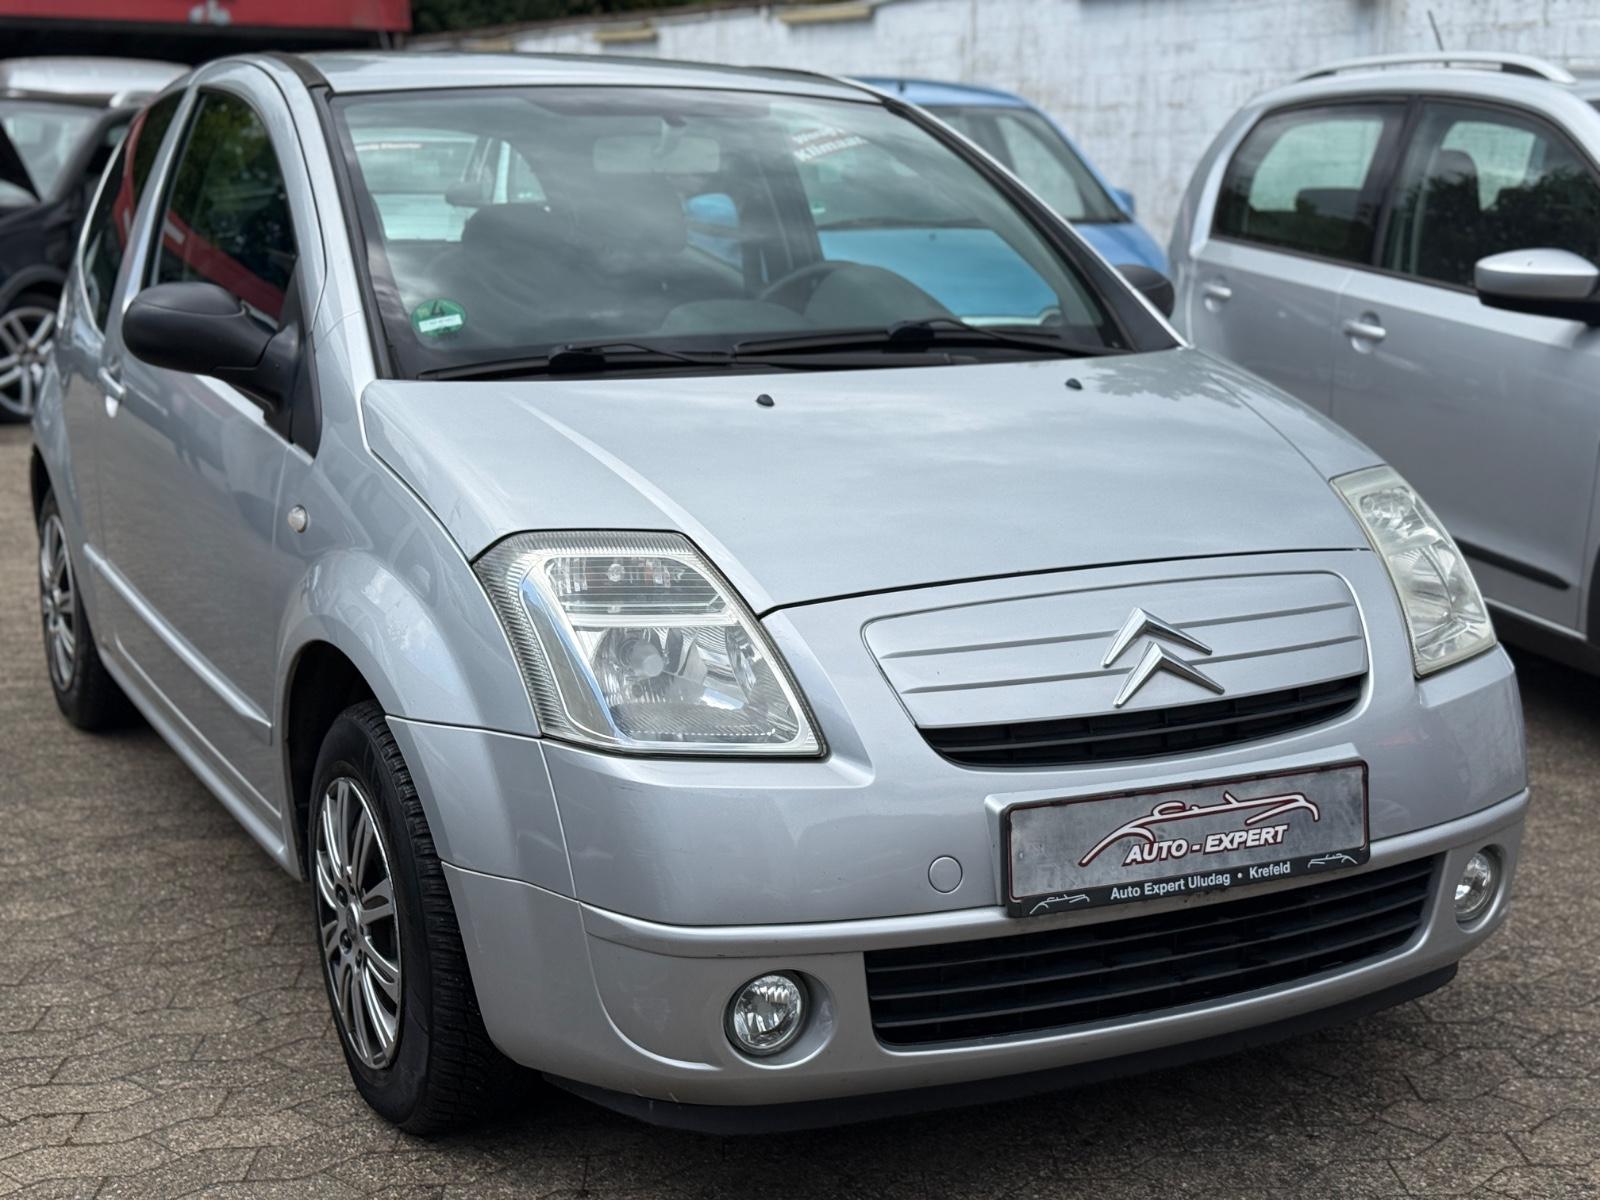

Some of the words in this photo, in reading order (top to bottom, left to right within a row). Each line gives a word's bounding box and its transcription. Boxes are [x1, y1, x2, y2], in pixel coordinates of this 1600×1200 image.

[1110, 886, 1141, 900] Auto
[1144, 878, 1185, 896] Expert
[1188, 871, 1231, 886] Uludag
[1249, 861, 1291, 880] Krefeld
